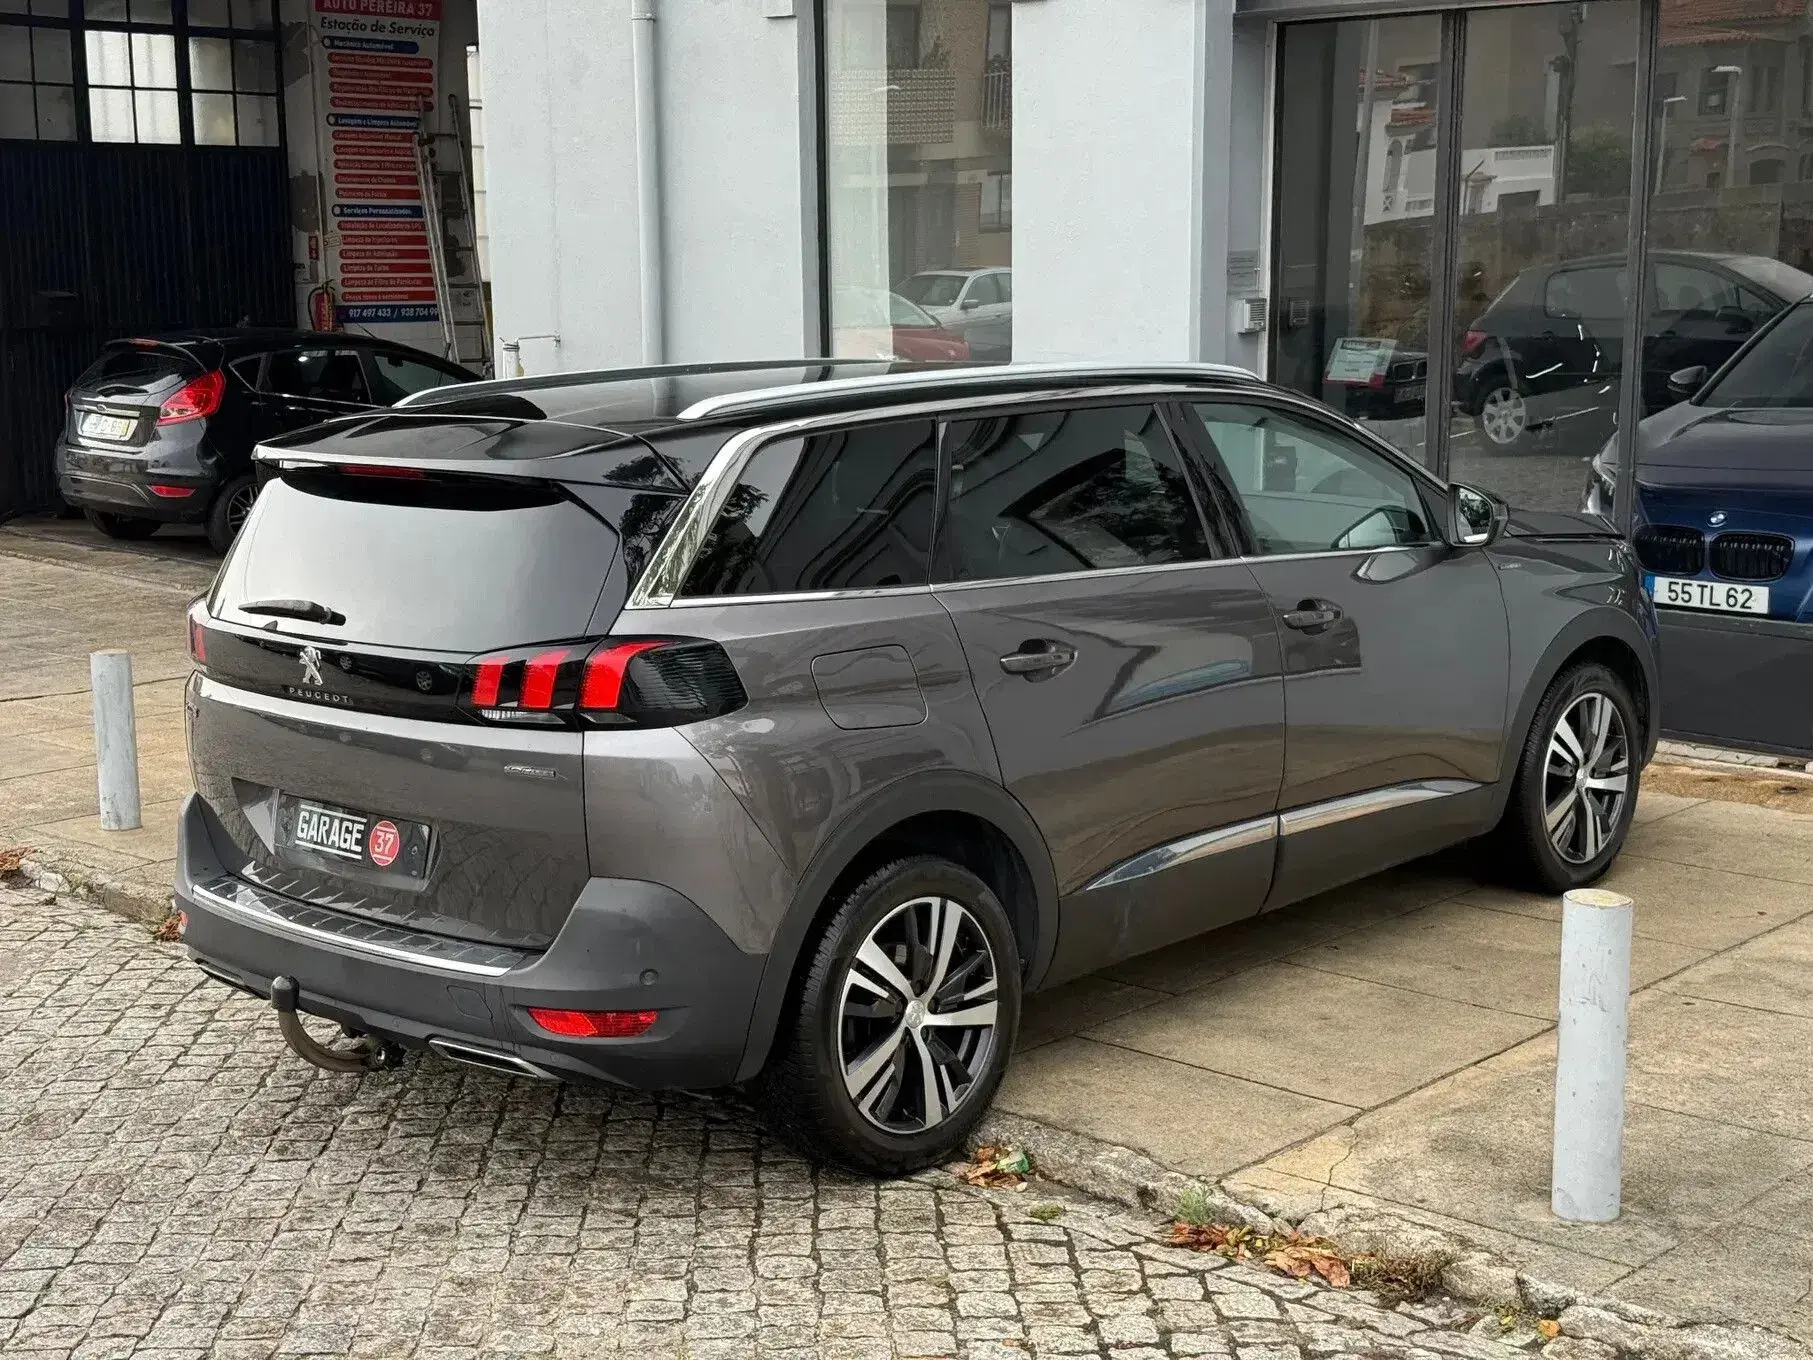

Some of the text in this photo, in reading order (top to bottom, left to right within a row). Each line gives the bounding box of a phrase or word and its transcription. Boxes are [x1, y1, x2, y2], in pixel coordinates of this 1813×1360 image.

[323, 0, 433, 17] AUTO PEREIRA 37
[320, 16, 435, 38] Estação de Serviço
[348, 308, 361, 318] 917
[362, 308, 376, 317] 497
[377, 308, 391, 317] 433
[400, 308, 415, 317] 938
[415, 307, 428, 316] 704
[429, 307, 438, 316] 99
[1668, 581, 1753, 610] 55 TL 62
[289, 687, 348, 703] PEUGEOT
[296, 811, 365, 853] GARAGE
[374, 831, 396, 855] 37
